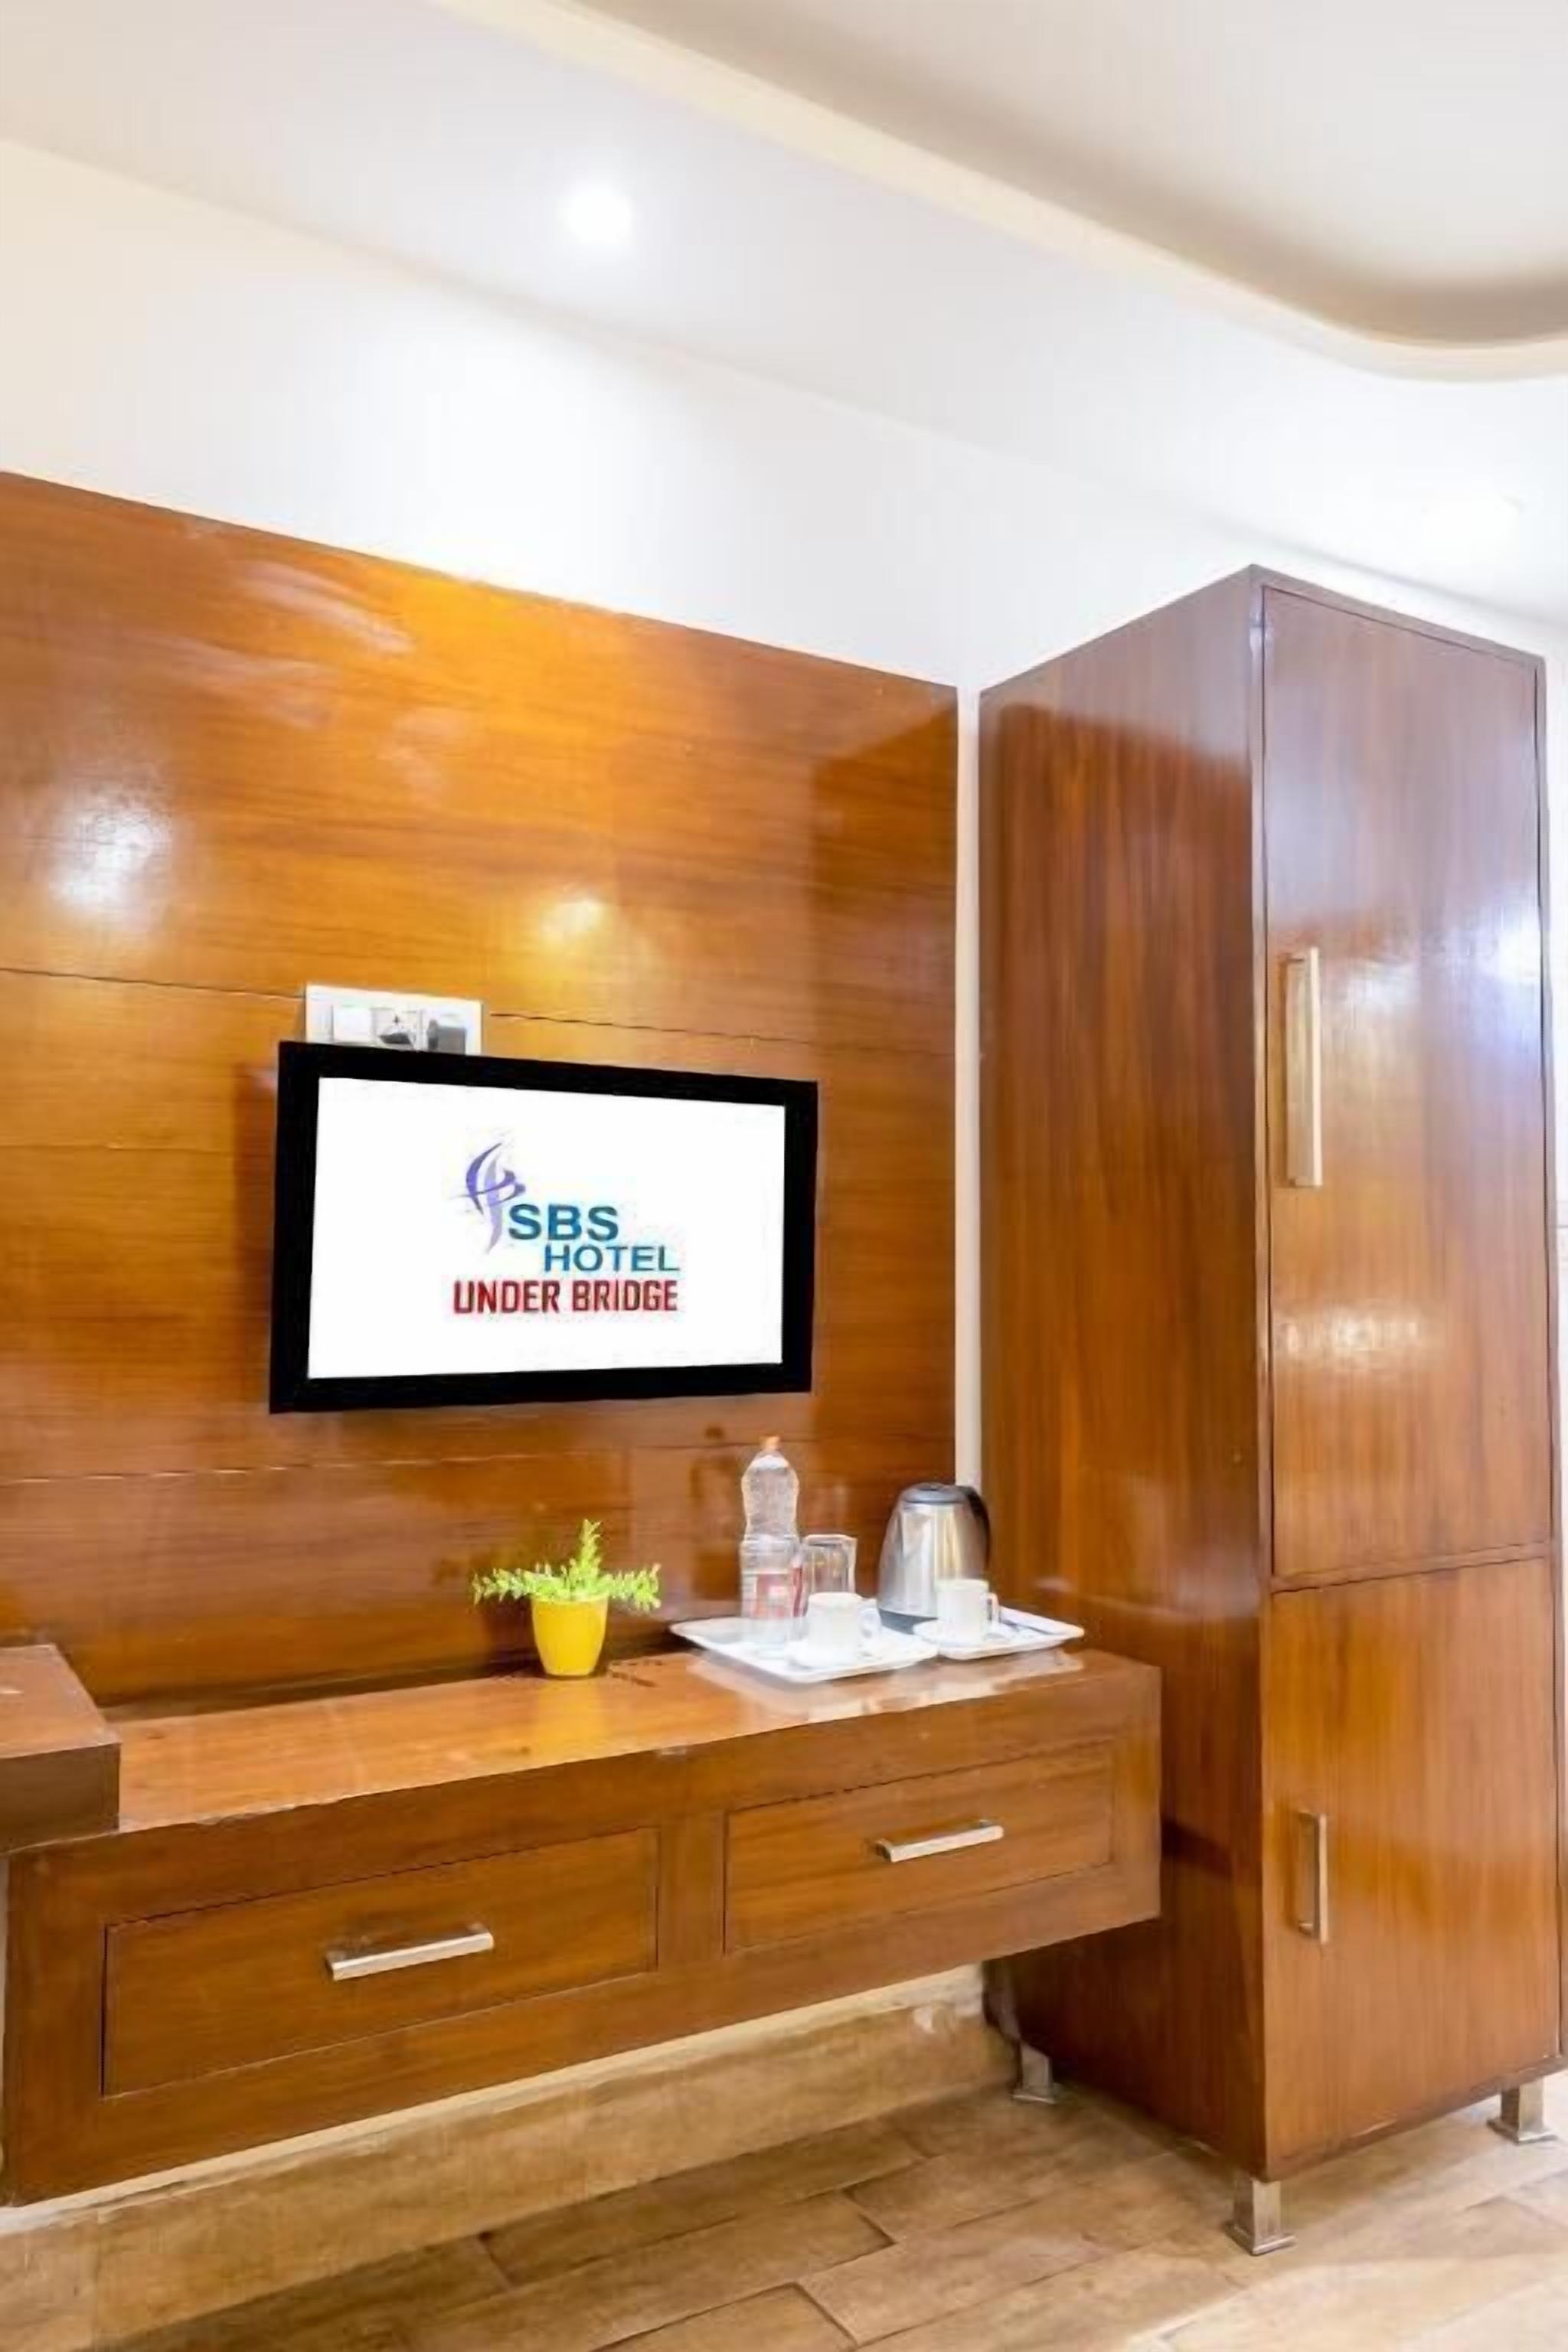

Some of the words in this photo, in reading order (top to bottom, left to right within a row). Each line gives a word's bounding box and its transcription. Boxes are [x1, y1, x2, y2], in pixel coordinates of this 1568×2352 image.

[509, 1204, 618, 1242] SBS
[544, 1244, 680, 1272] HOTEL
[454, 1280, 560, 1314] UNDER
[572, 1279, 678, 1312] BRIDGE
